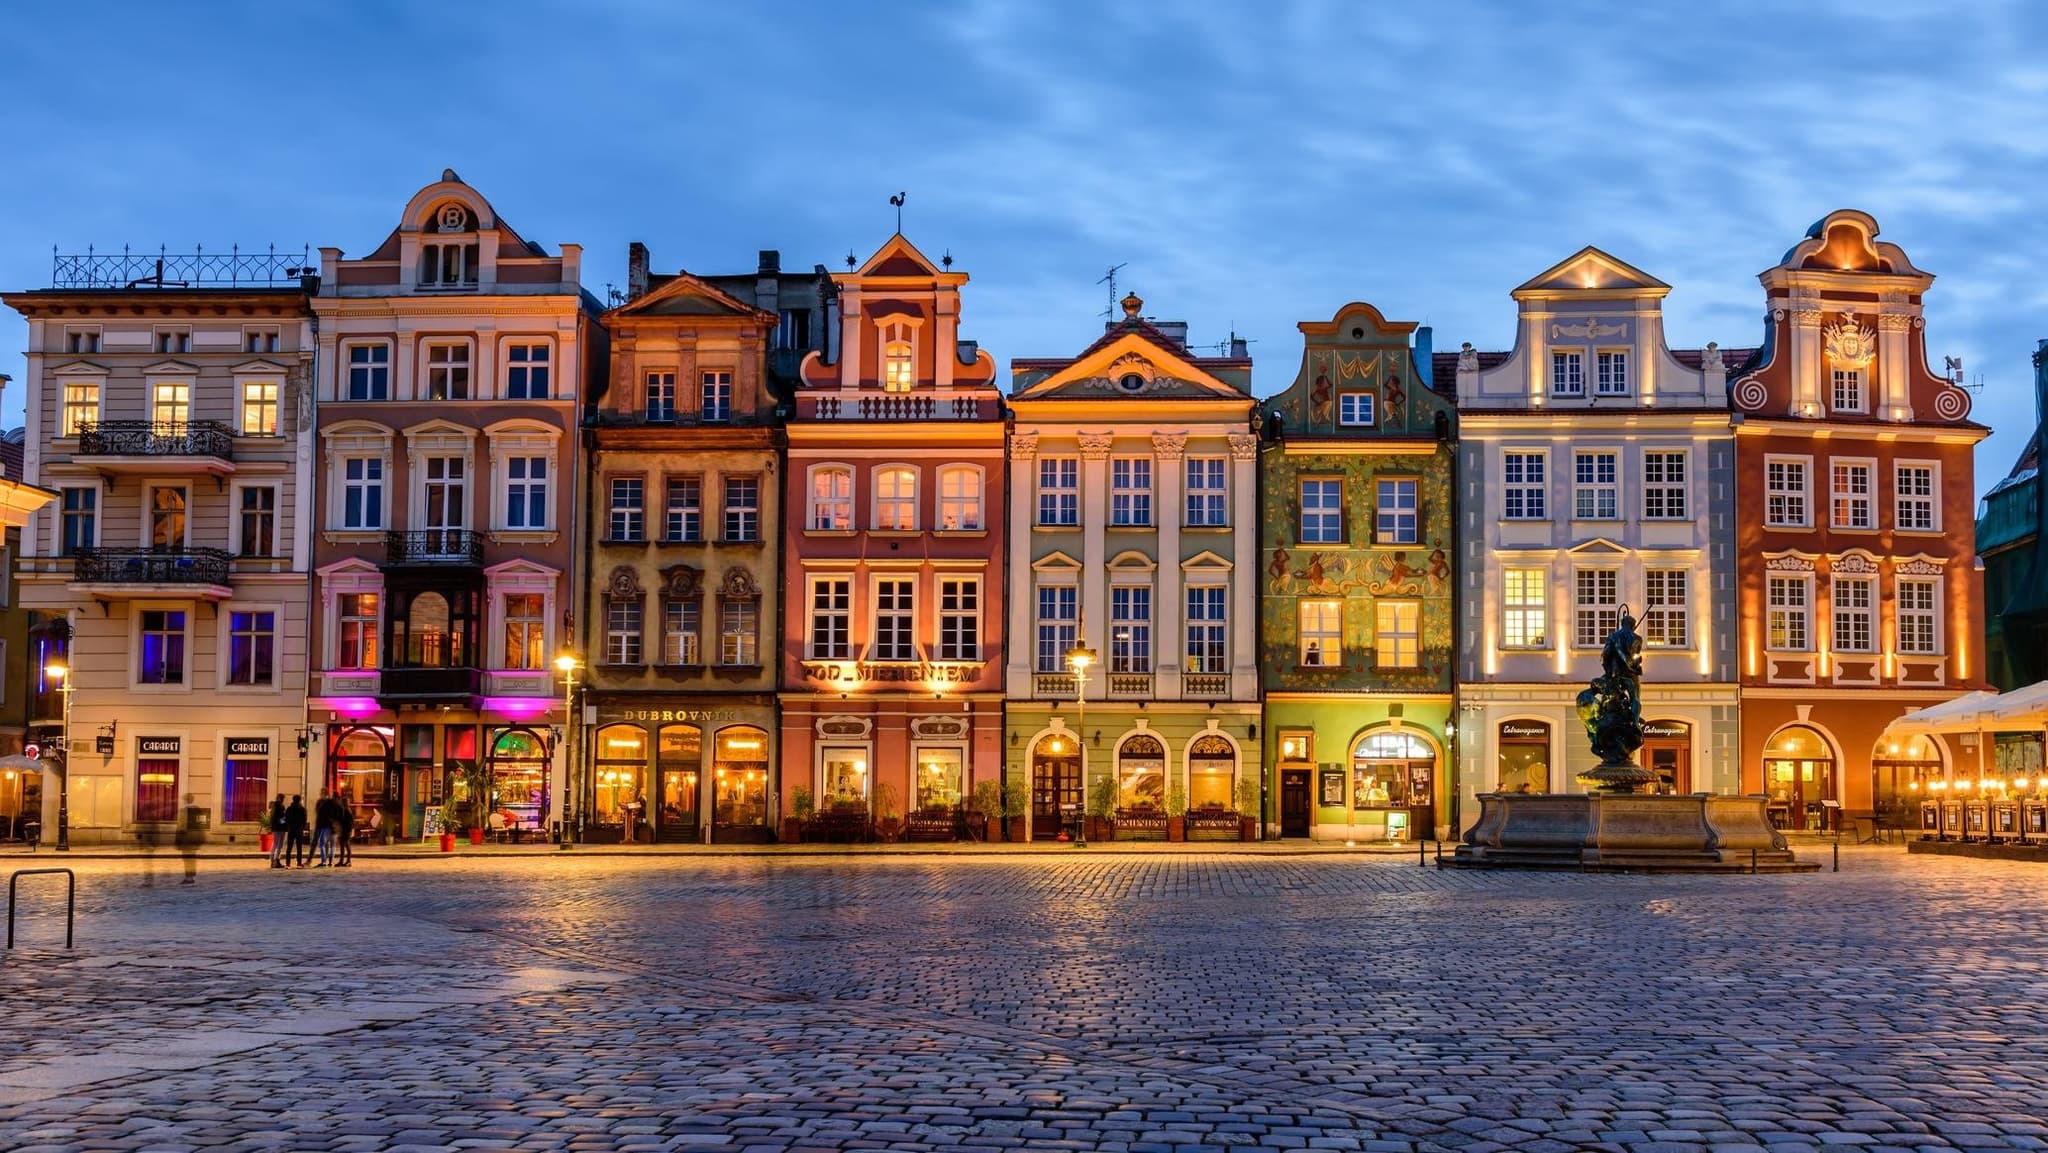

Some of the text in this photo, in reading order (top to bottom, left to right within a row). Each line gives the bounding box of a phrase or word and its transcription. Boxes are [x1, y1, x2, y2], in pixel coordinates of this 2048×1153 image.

[624, 710, 735, 721] DUBROVNIK
[143, 741, 179, 752] CABARET
[231, 742, 268, 753] CABARET
